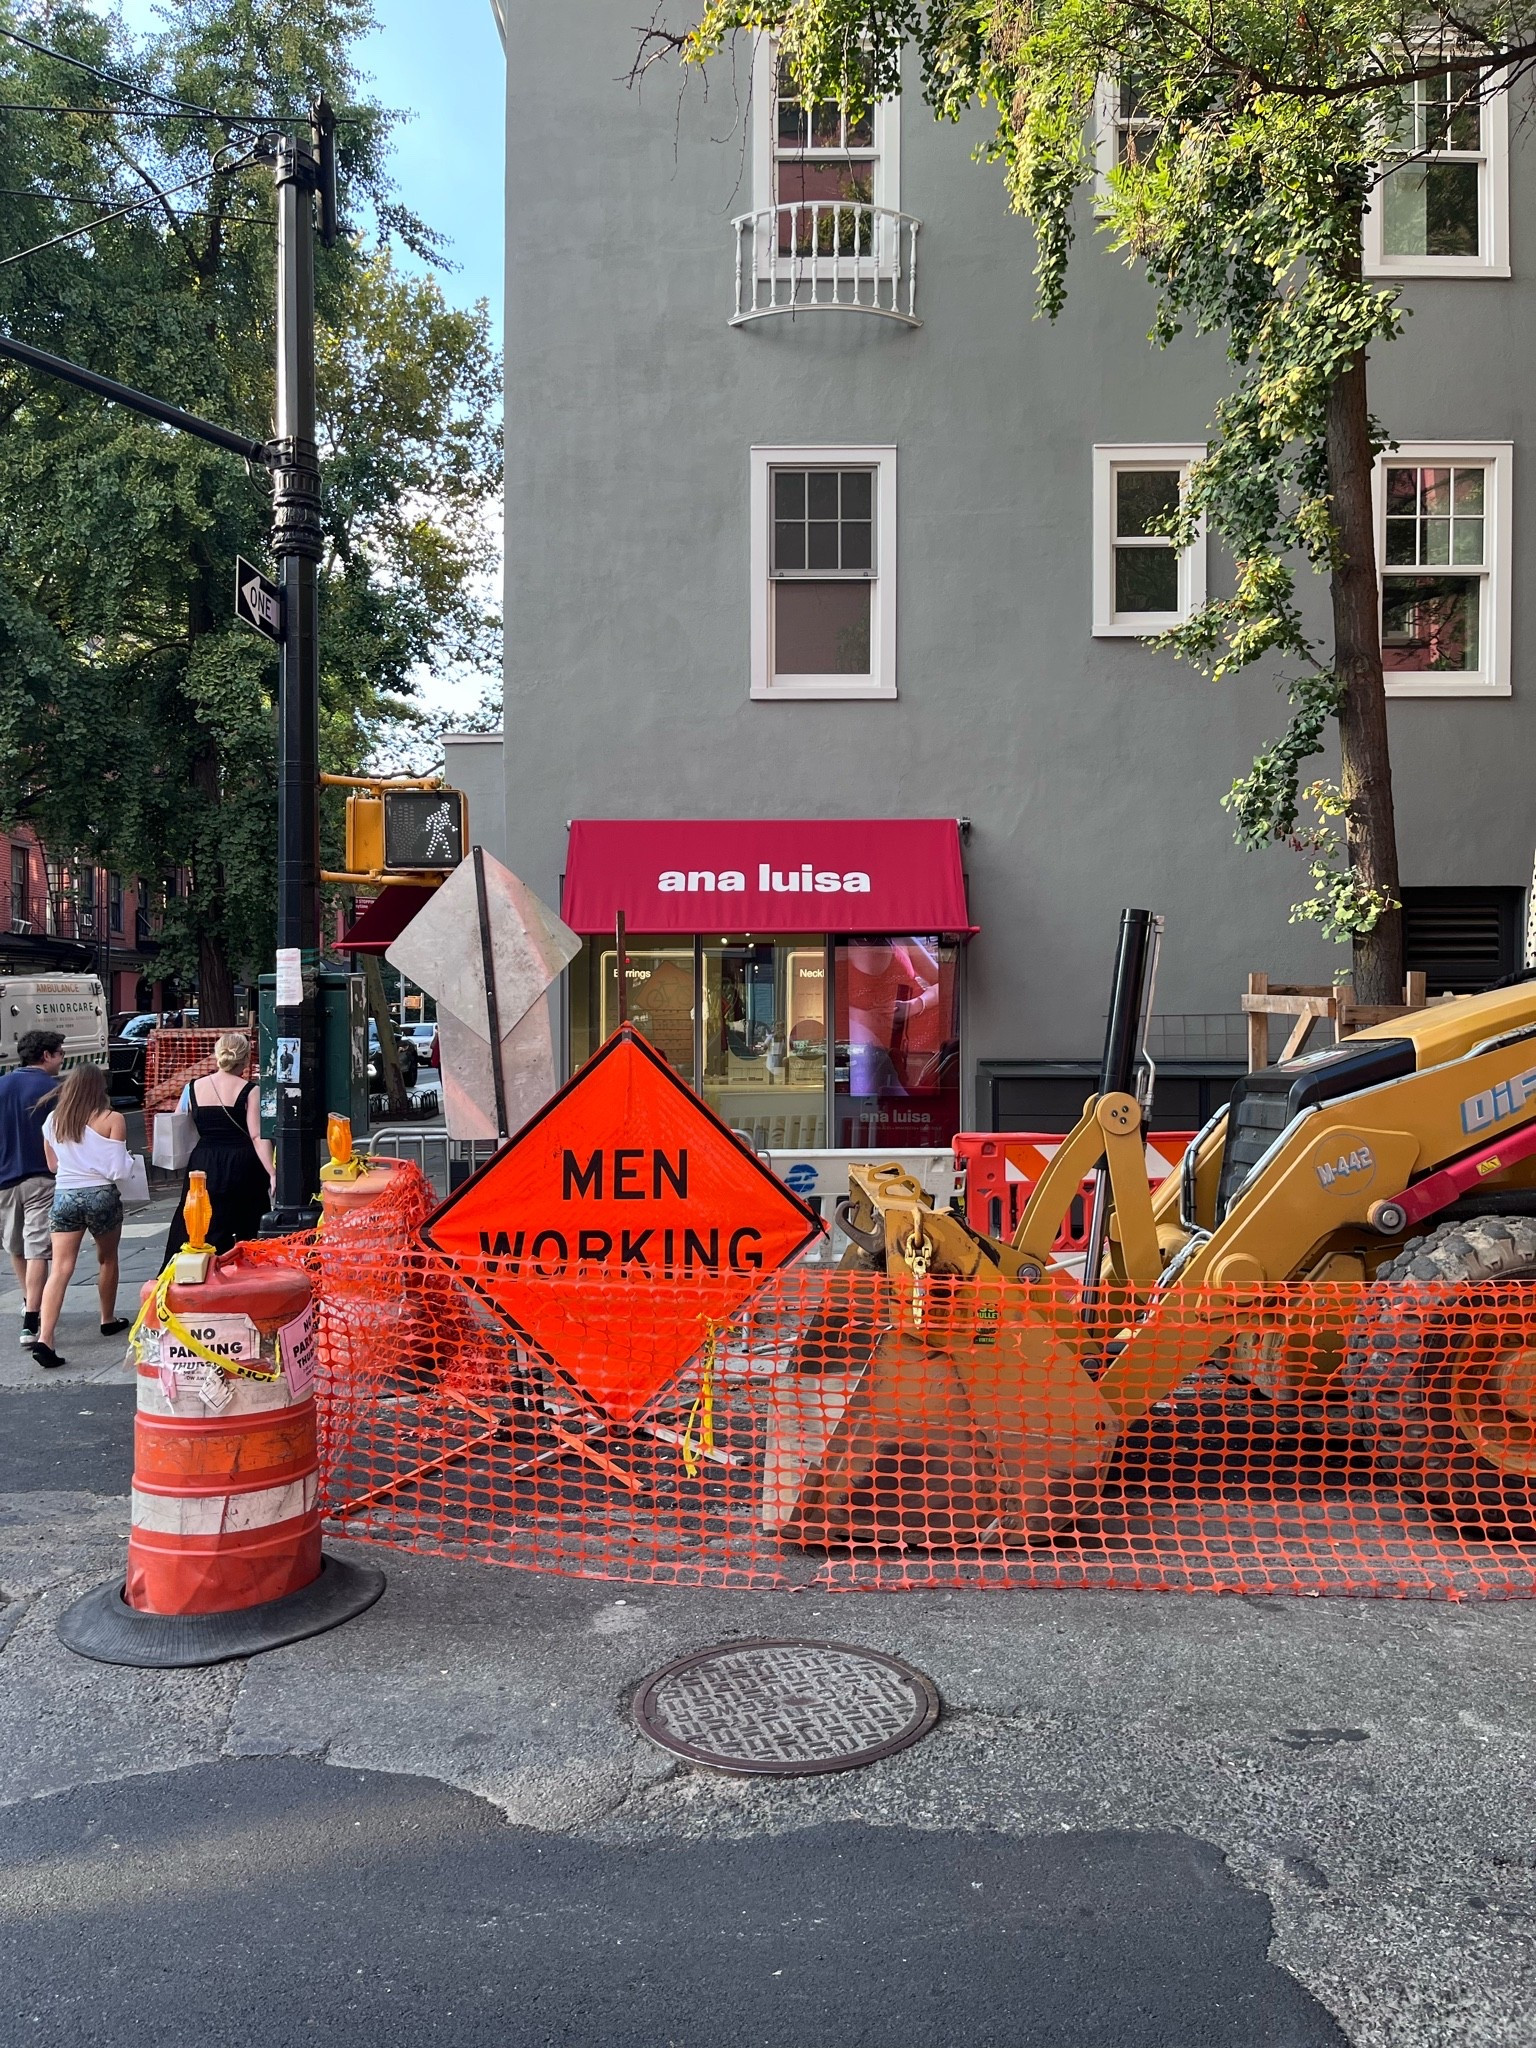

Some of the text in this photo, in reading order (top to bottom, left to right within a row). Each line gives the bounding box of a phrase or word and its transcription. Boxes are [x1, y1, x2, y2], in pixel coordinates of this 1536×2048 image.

[251, 586, 271, 620] ONE
[657, 863, 871, 893] ana luisa
[613, 968, 652, 980] Errings
[36, 983, 80, 993] AMBULANCE
[35, 1002, 94, 1014] SENIORCARE
[860, 1109, 931, 1123] ana luisa
[562, 1148, 688, 1201] MEN
[1316, 1146, 1373, 1187] M-442
[479, 1226, 763, 1281] WORKING
[190, 1328, 216, 1341] NO
[169, 1341, 243, 1358] PARING
